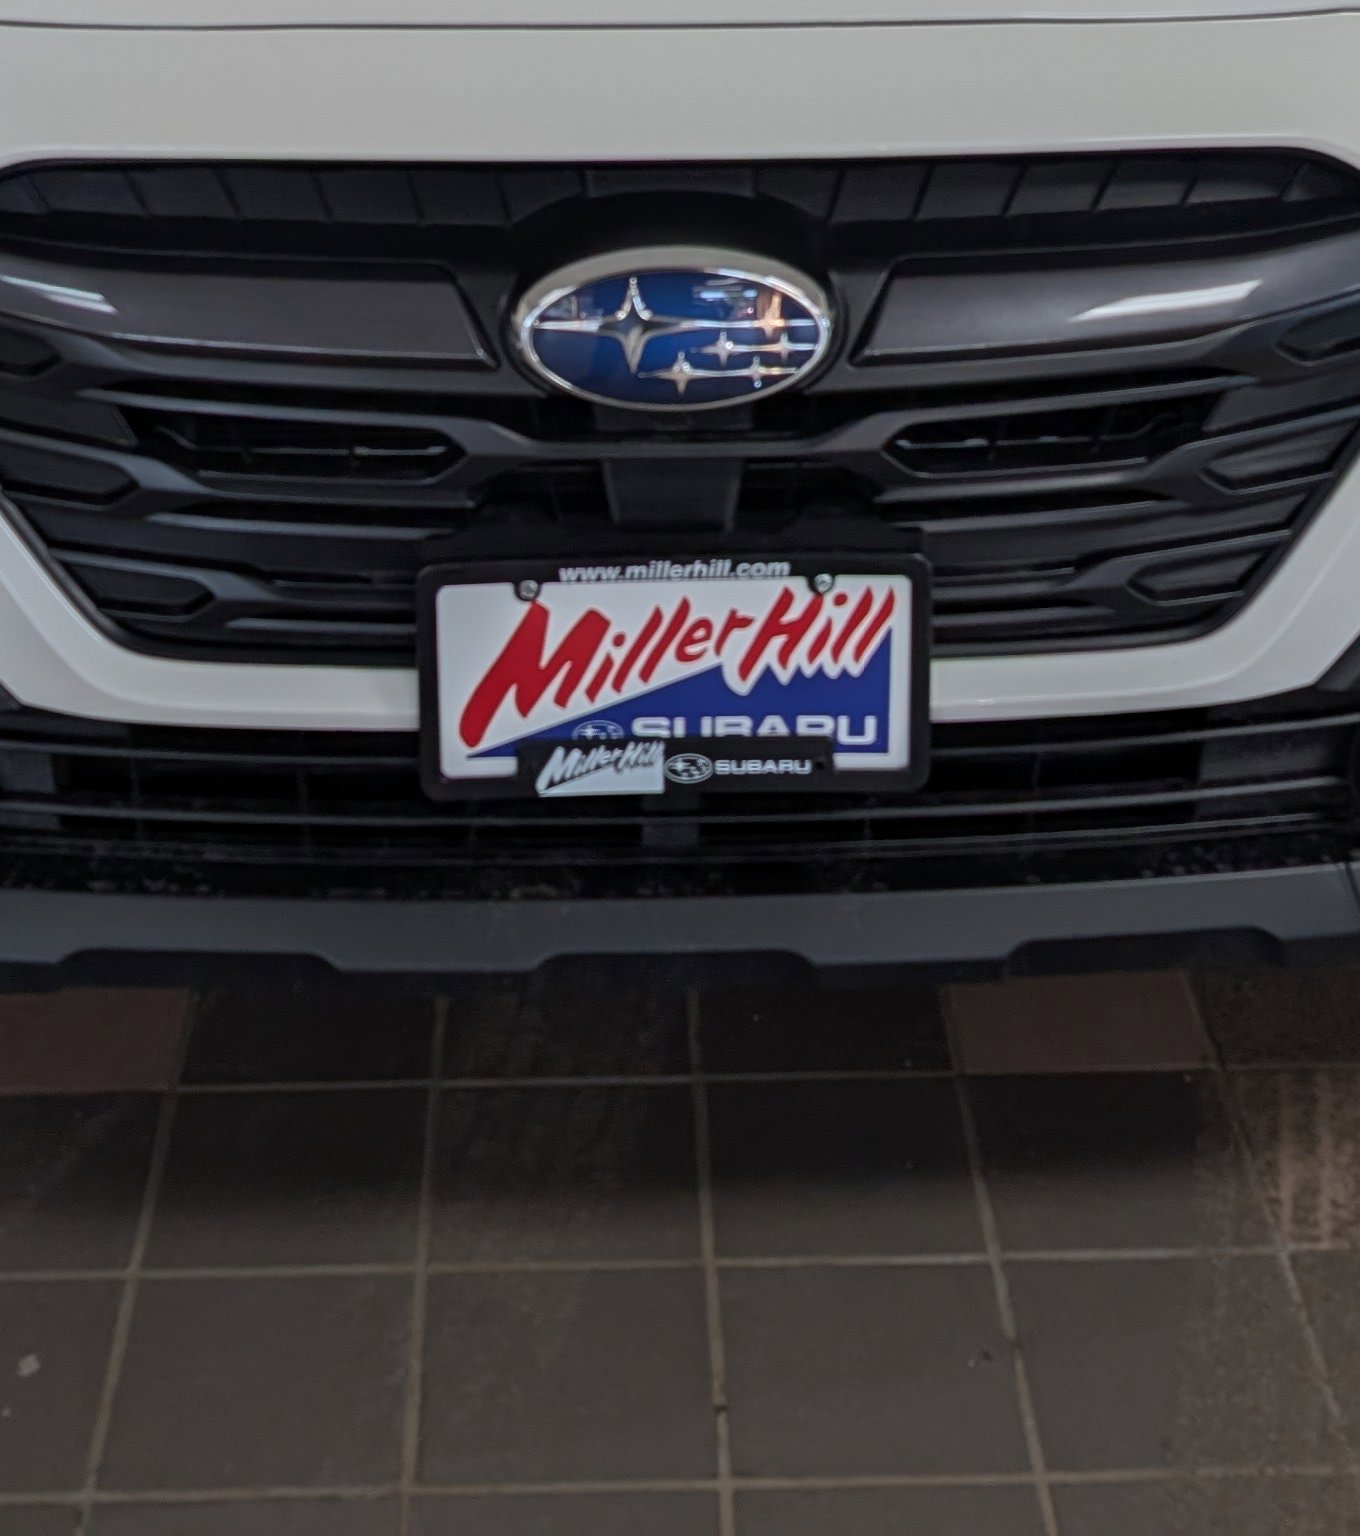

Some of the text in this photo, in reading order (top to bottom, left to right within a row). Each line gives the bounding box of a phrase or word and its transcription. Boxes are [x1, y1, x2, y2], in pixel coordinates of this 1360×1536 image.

[558, 559, 791, 583] www.millerhill.com
[630, 714, 878, 746] SUBARU
[713, 759, 814, 776] SUBARU
